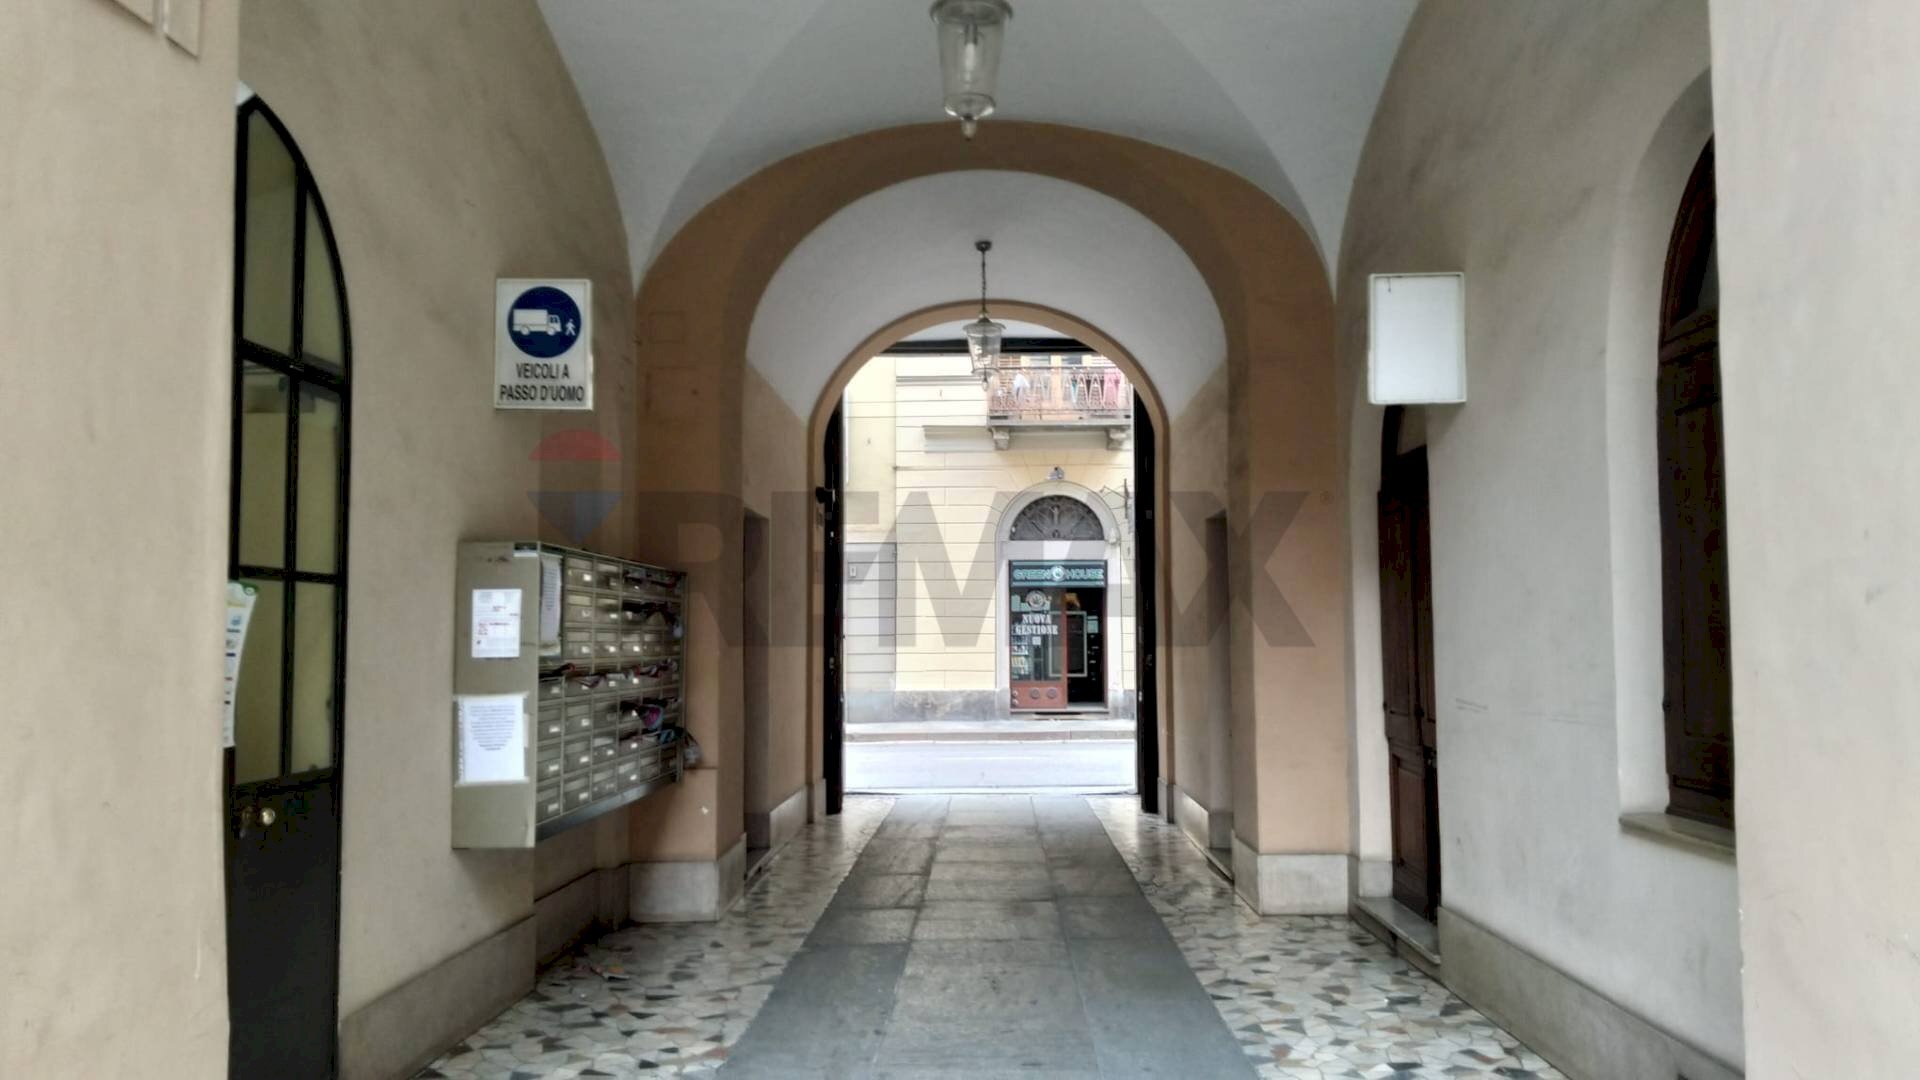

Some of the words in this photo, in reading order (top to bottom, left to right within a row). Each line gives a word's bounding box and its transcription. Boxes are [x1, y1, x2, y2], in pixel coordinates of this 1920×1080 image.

[516, 363, 559, 379] VEICOLI
[562, 363, 570, 379] A
[501, 385, 537, 400] PASSO
[540, 386, 585, 401] D'UOMO
[1013, 569, 1051, 580] GREEN
[1066, 569, 1104, 580] HOUSE
[1022, 613, 1052, 624] NUOVA
[1015, 624, 1058, 635] GESTIONE
